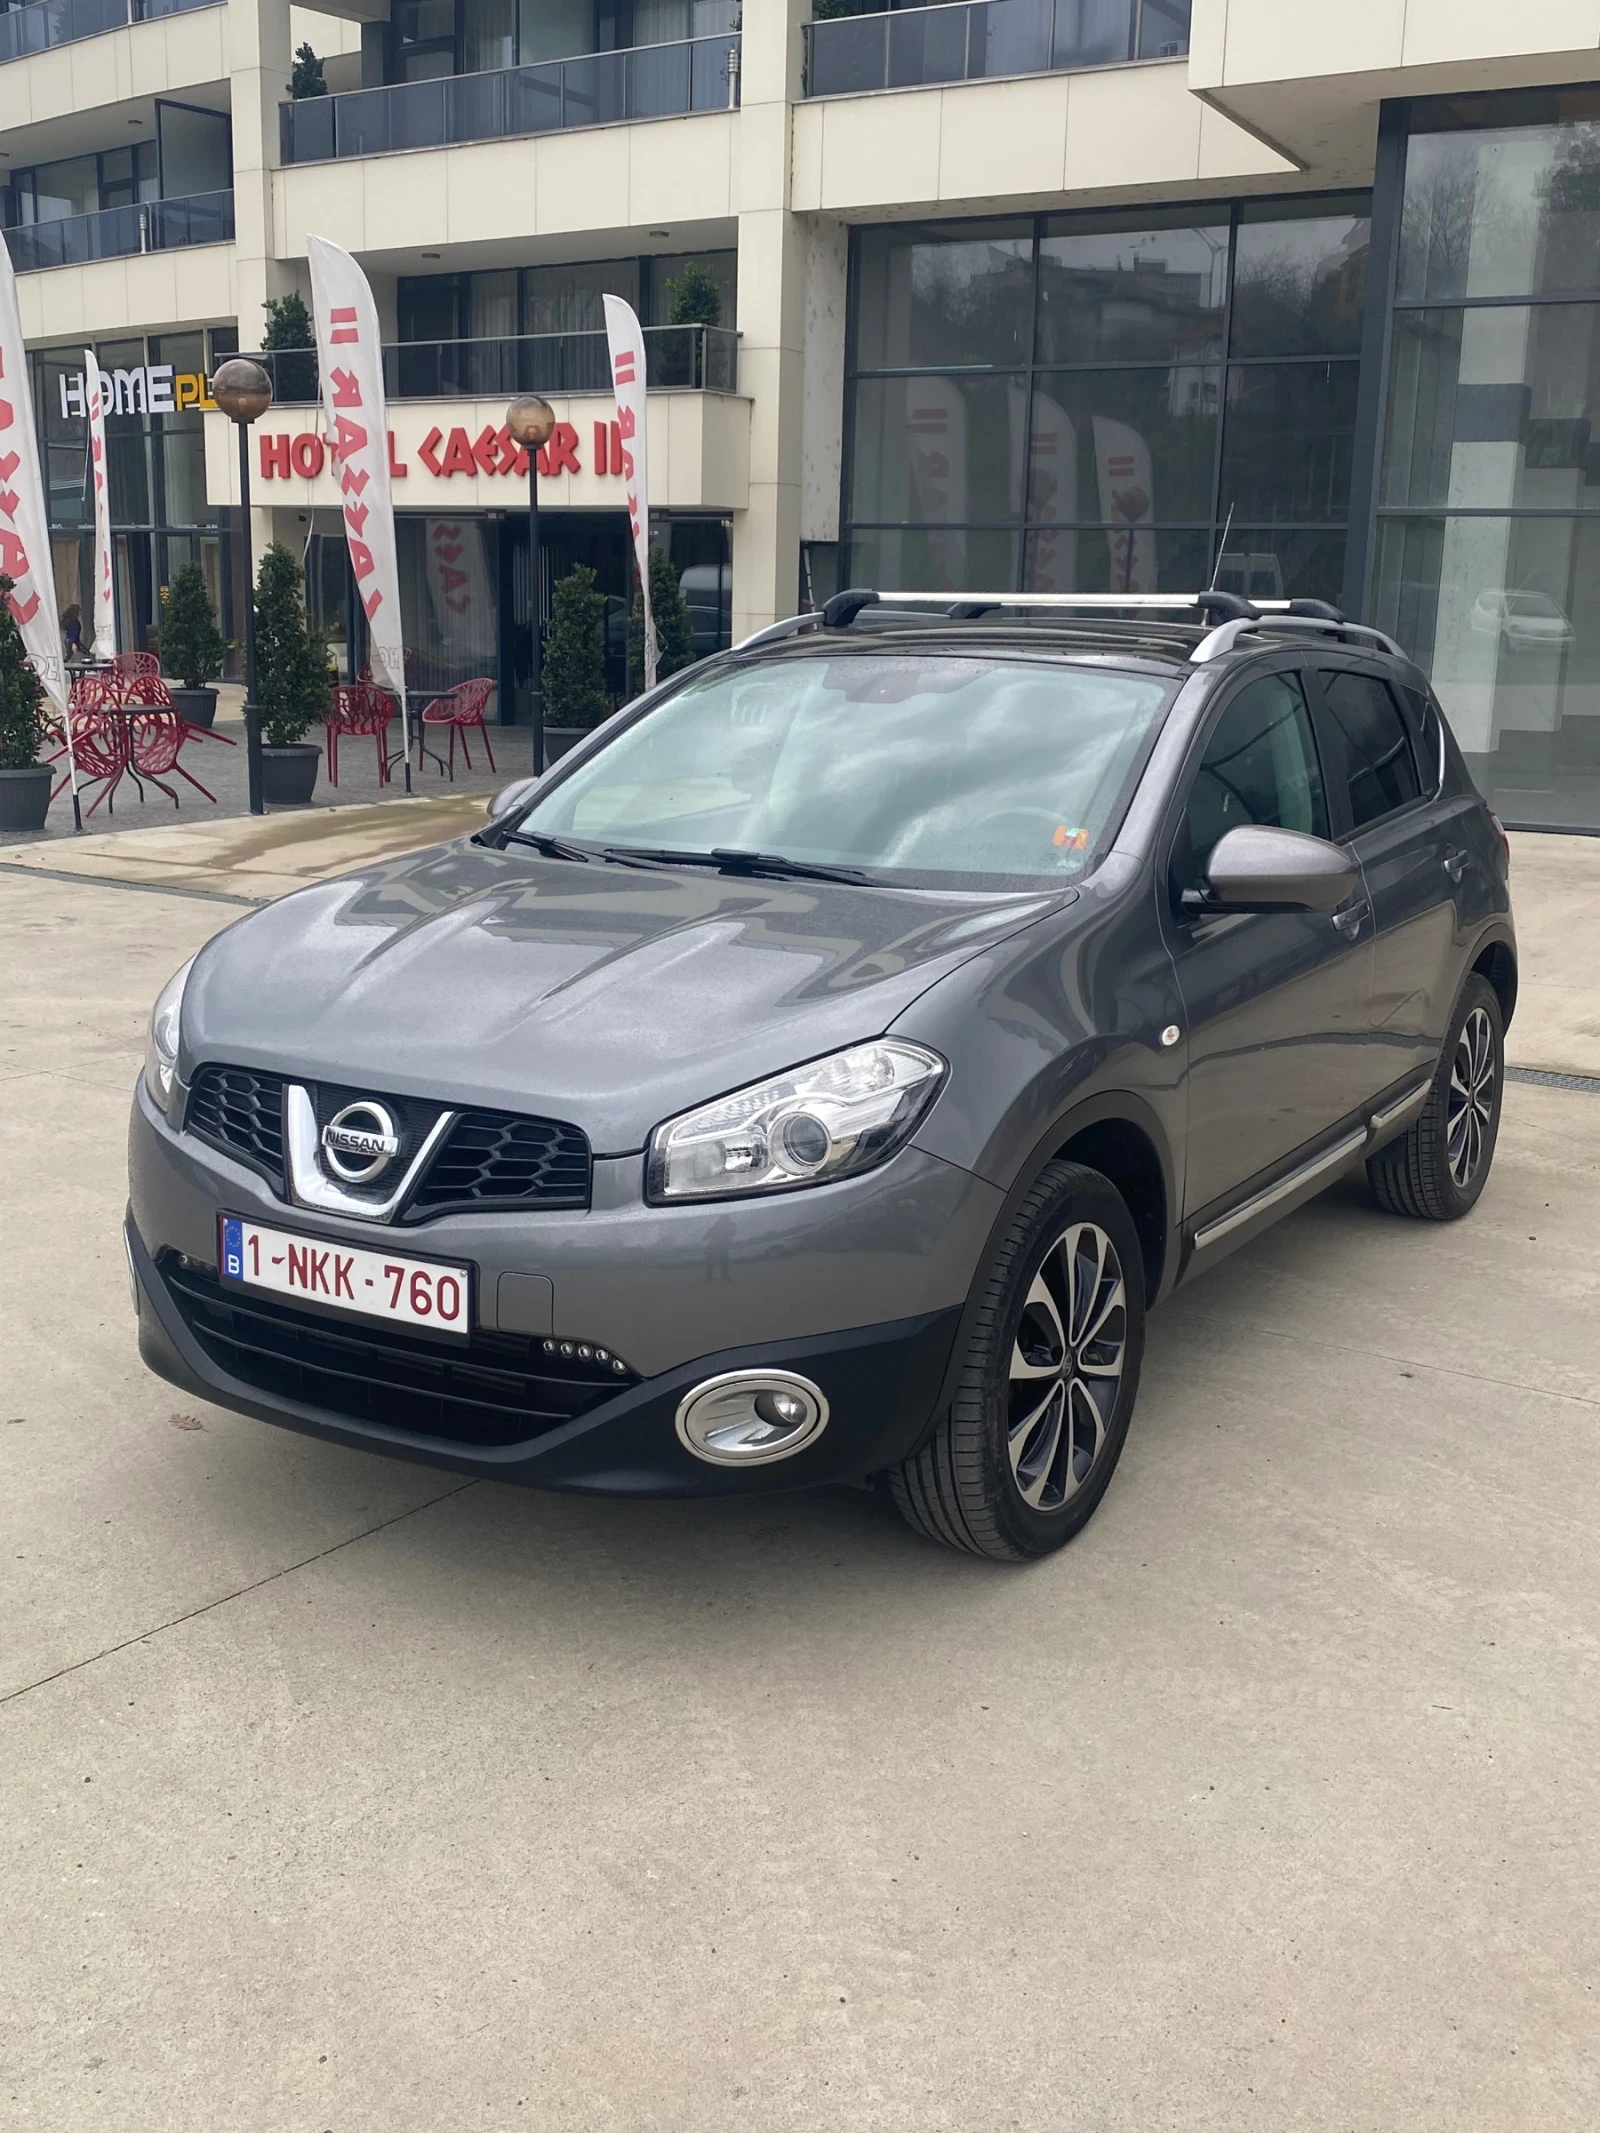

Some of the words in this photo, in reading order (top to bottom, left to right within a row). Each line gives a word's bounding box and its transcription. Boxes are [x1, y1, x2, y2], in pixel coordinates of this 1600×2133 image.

[259, 431, 408, 479] HOL
[417, 421, 582, 477] CAESAR
[593, 420, 622, 475] II
[325, 1129, 385, 1152] NISSAN
[228, 1253, 240, 1275] B
[248, 1234, 460, 1321] 1-NKK-760
